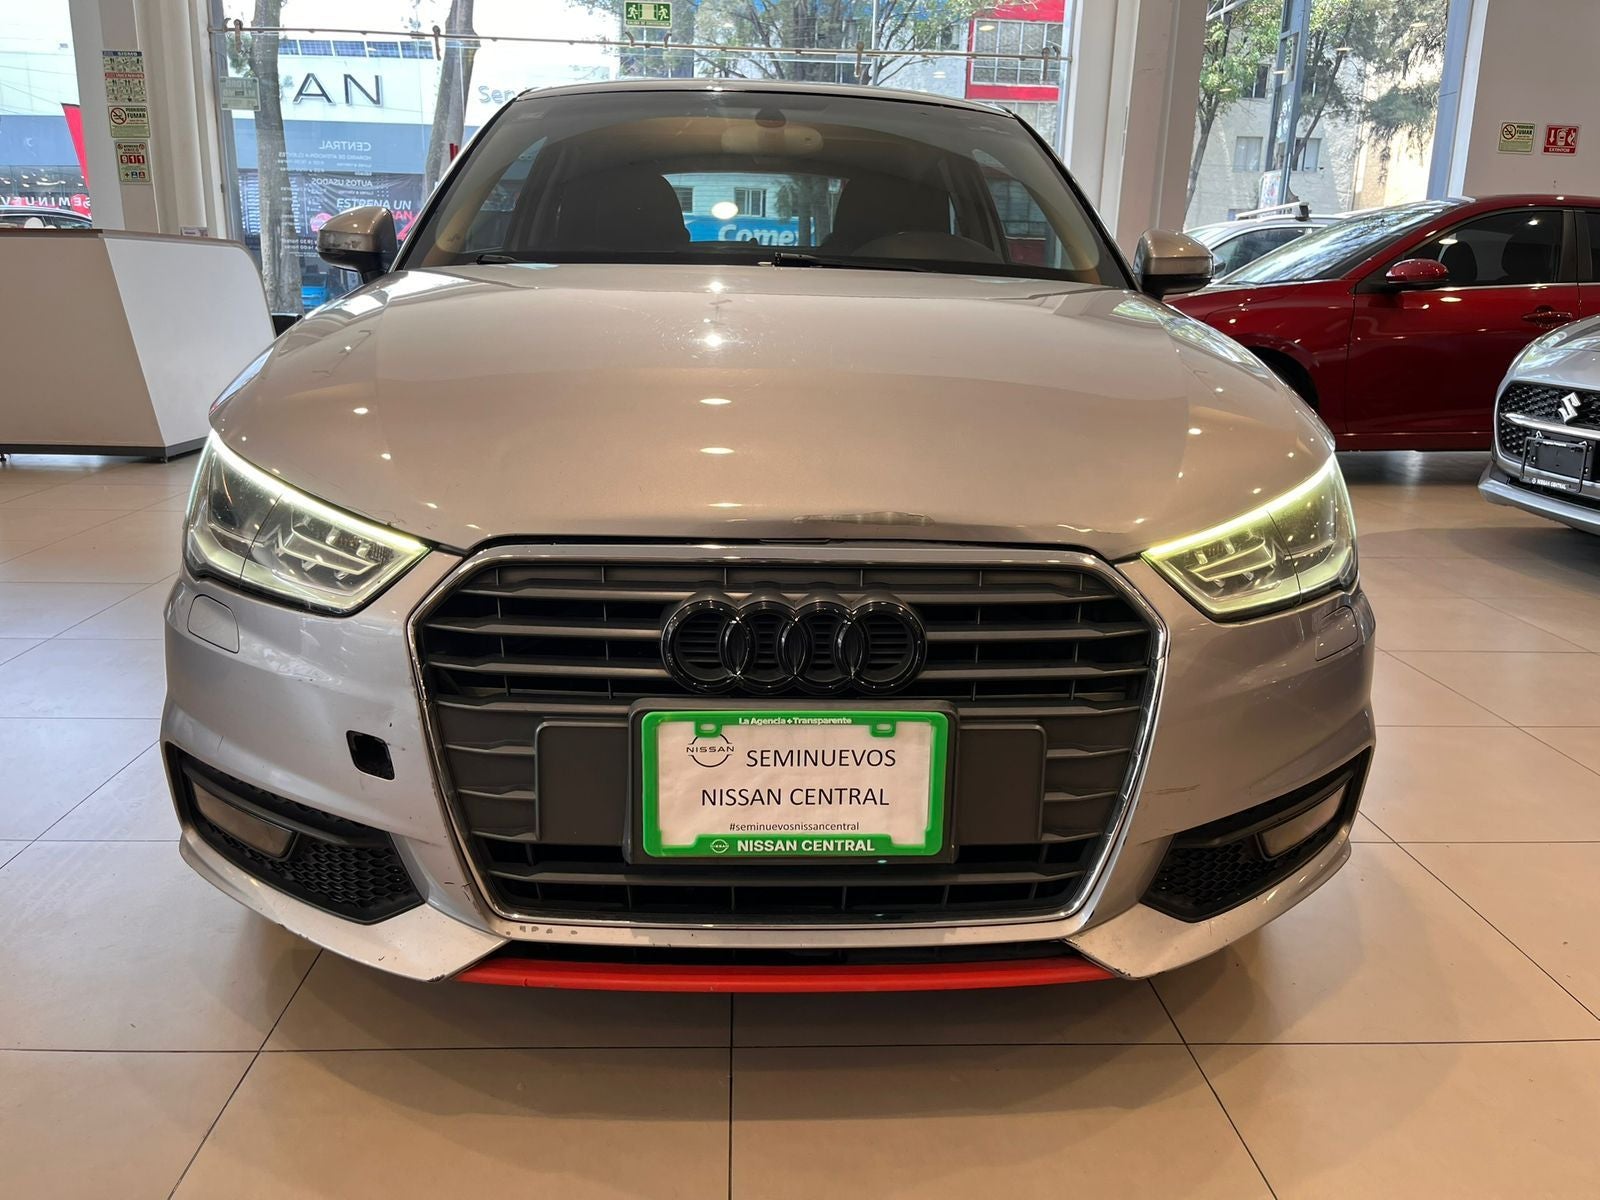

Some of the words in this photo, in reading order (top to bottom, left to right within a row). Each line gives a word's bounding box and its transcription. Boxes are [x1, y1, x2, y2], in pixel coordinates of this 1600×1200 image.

[120, 155, 145, 164] 911
[336, 199, 391, 210] ESTRENA
[393, 200, 413, 210] UN
[718, 224, 799, 246] Come
[750, 718, 786, 726] Agencia
[746, 749, 896, 767] SEMINUEVOS
[701, 788, 782, 806] NISSAN
[790, 788, 890, 806] CENTRAL
[729, 822, 859, 832] #seminuevosnissancentral
[737, 840, 797, 852] NISSAN
[801, 839, 875, 852] CENTRAL
